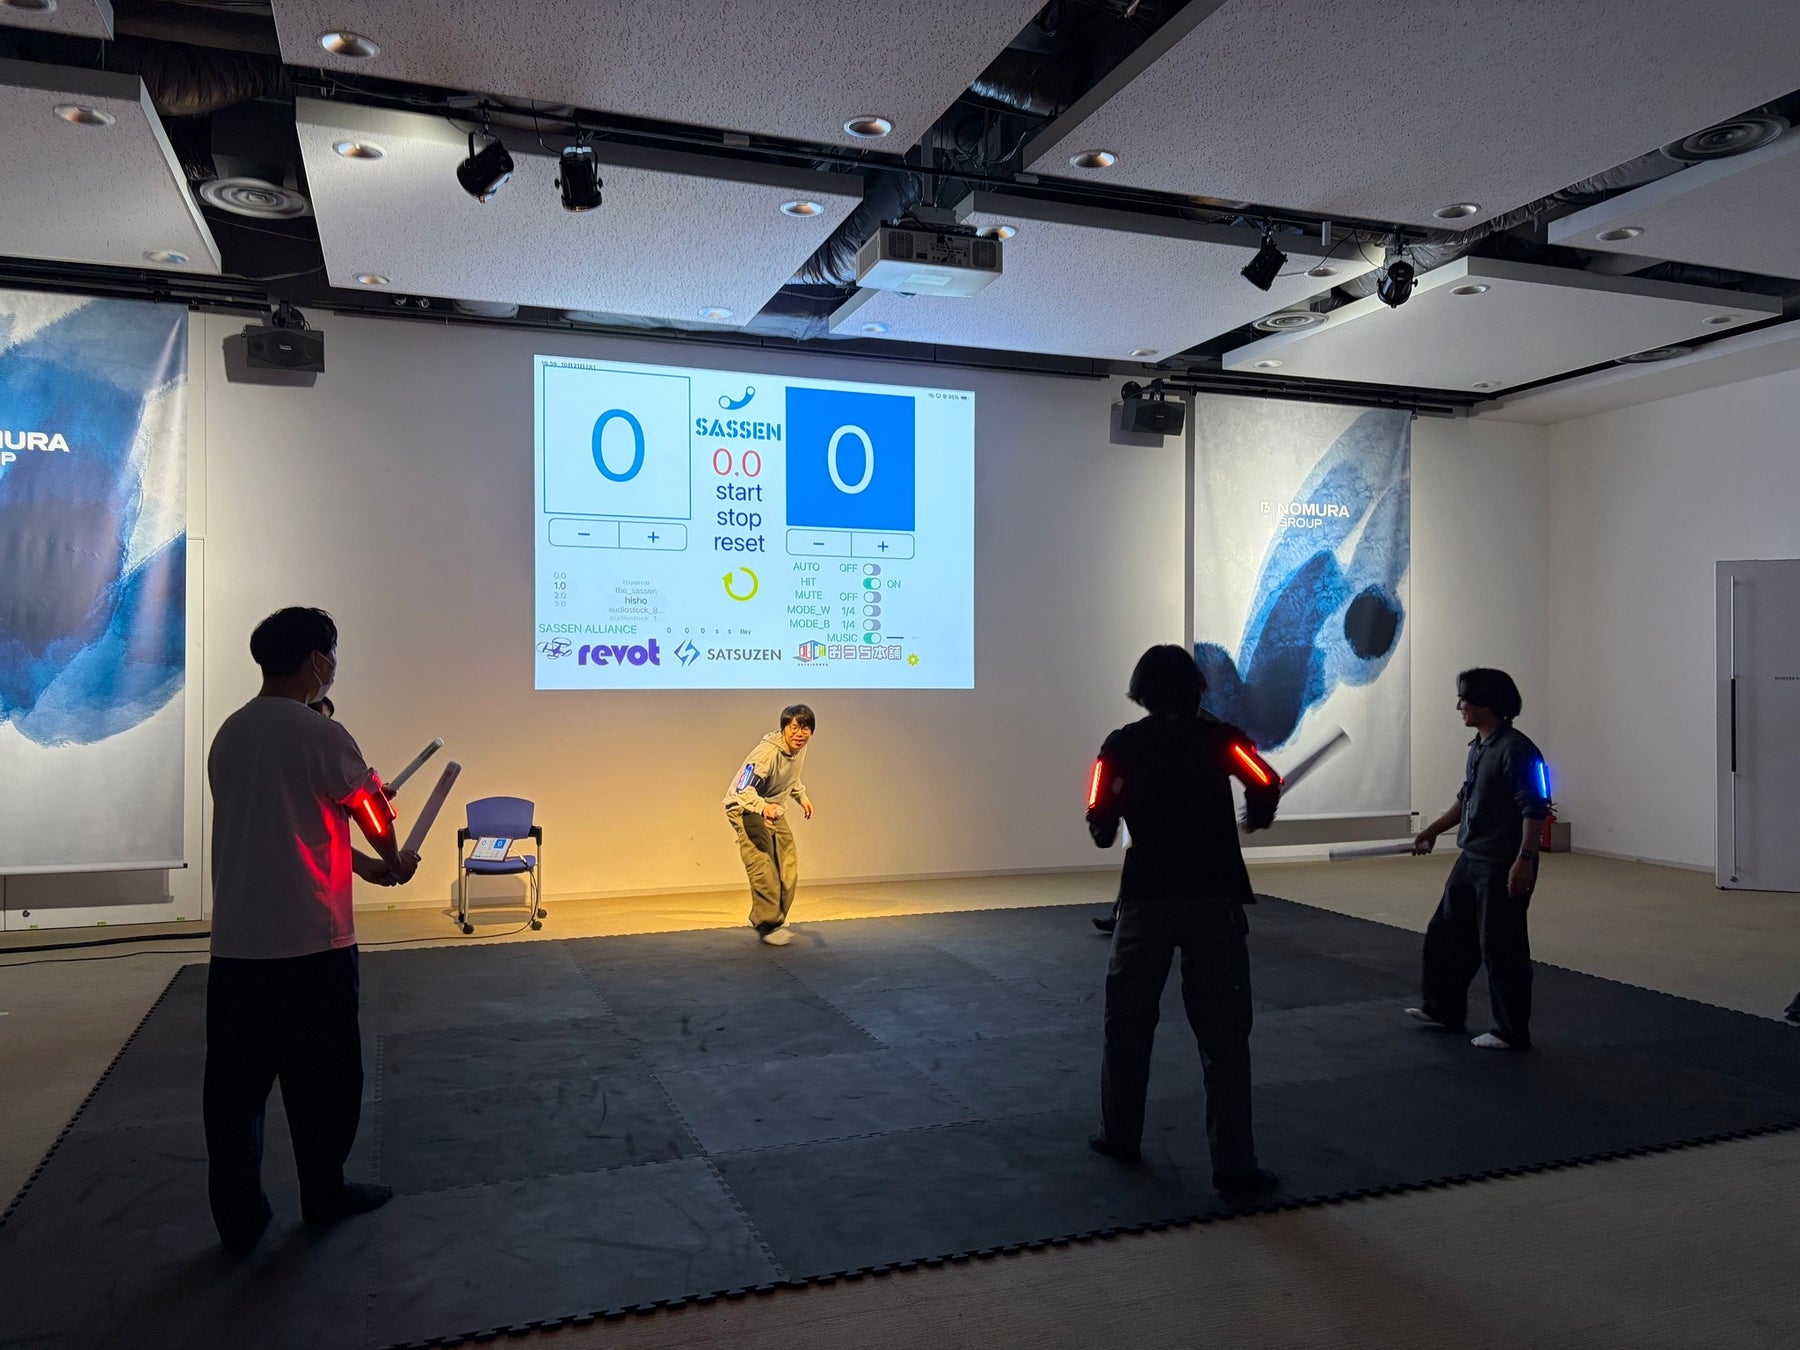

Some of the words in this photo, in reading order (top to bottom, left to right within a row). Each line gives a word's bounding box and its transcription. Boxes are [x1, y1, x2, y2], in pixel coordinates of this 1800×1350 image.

[695, 417, 782, 441] SASSEN
[0, 430, 70, 452] URA
[591, 408, 646, 483] 0
[712, 448, 762, 478] 0.0
[827, 424, 875, 494] 0
[716, 482, 763, 502] start
[1277, 502, 1350, 518] NOMURA
[716, 508, 762, 531] stop
[1278, 517, 1323, 529] GROUP
[714, 535, 765, 553] reset
[793, 562, 820, 572] AUTO
[839, 563, 858, 573] OFF
[553, 572, 567, 580] 0.0
[553, 581, 567, 590] 1.0
[800, 577, 817, 587] HIT
[887, 579, 901, 589] ON
[624, 596, 648, 605] hisho
[795, 590, 823, 600] MUTE
[839, 592, 858, 602] OFF
[787, 605, 831, 616] MODE_W
[841, 606, 855, 617] 1/4
[538, 623, 582, 633] SASSEN
[585, 624, 637, 635] ALLIANCE
[789, 619, 831, 629] MODE_B
[841, 620, 855, 630] 1/4
[827, 633, 858, 643] MUSIC
[578, 638, 660, 666] revot
[707, 648, 782, 661] SATSUZEN
